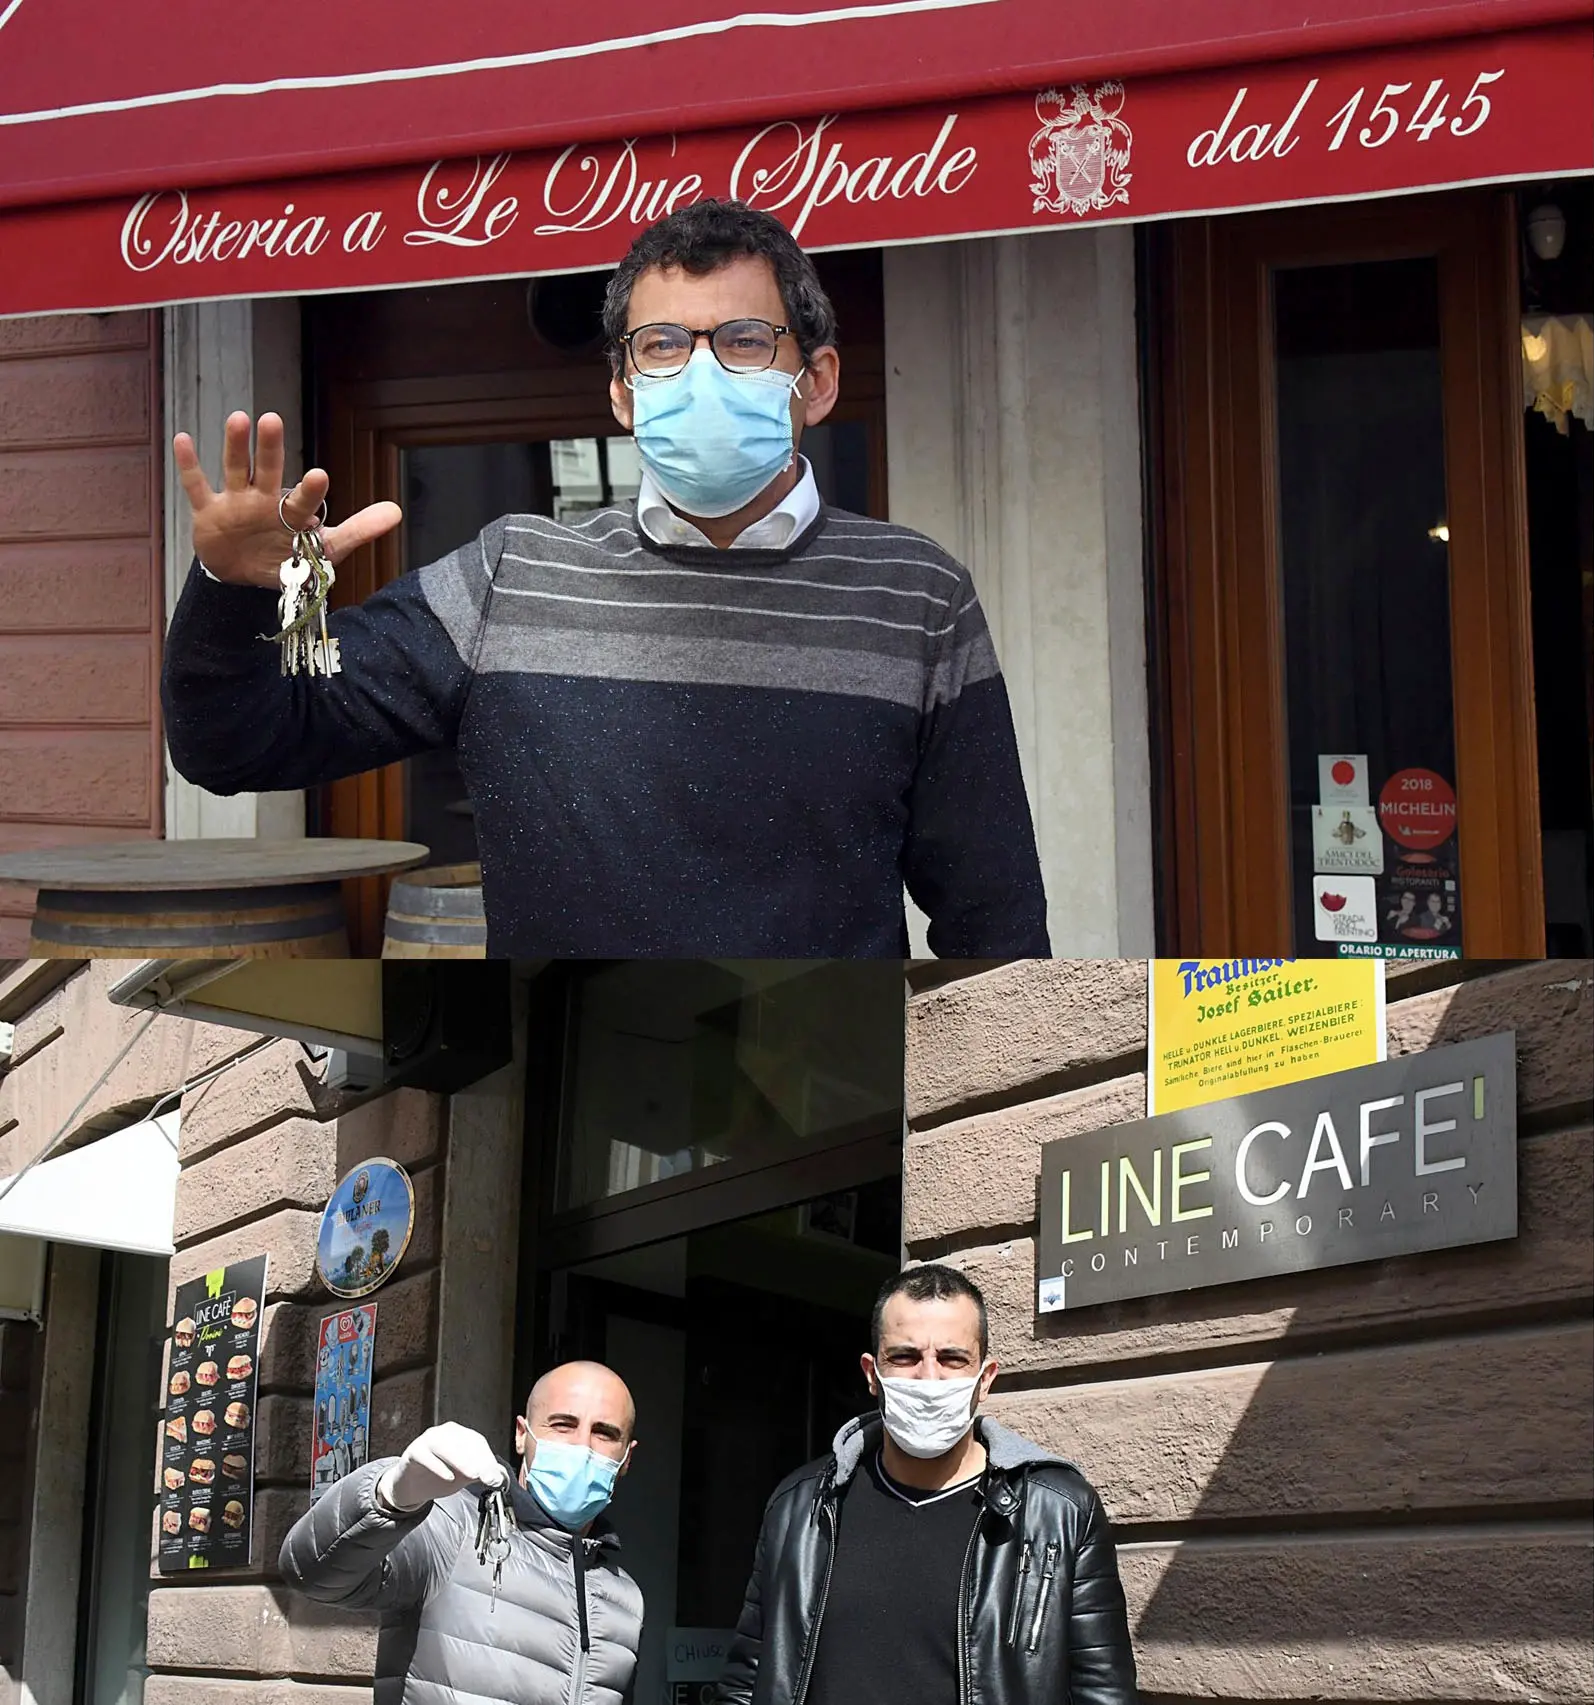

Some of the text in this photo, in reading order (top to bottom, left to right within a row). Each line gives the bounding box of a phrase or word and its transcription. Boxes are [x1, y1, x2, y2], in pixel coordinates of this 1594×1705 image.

[121, 69, 1505, 272] Osteria a Le Due Spade dal 1545
[1401, 778, 1433, 791] 2018
[1380, 801, 1456, 816] MICHELIN
[1340, 944, 1459, 960] ORARIO DI APERTURA
[1225, 973, 1279, 996] Besitzer
[1197, 995, 1240, 1023] Josef
[1163, 1047, 1184, 1061] HELLE
[1193, 1034, 1227, 1052] DUNKLE
[1214, 1045, 1232, 1058] HELL
[1287, 1013, 1355, 1037] WEIZENBIER
[1203, 1064, 1223, 1075] Biere
[1226, 1058, 1242, 1068] sind
[1246, 1053, 1262, 1063] hier
[1266, 1050, 1274, 1059] in
[1274, 1060, 1285, 1068] zu
[1290, 1052, 1320, 1064] haben
[1062, 1136, 1214, 1245] LINE
[1061, 1182, 1484, 1277] CONTEMPORARY
